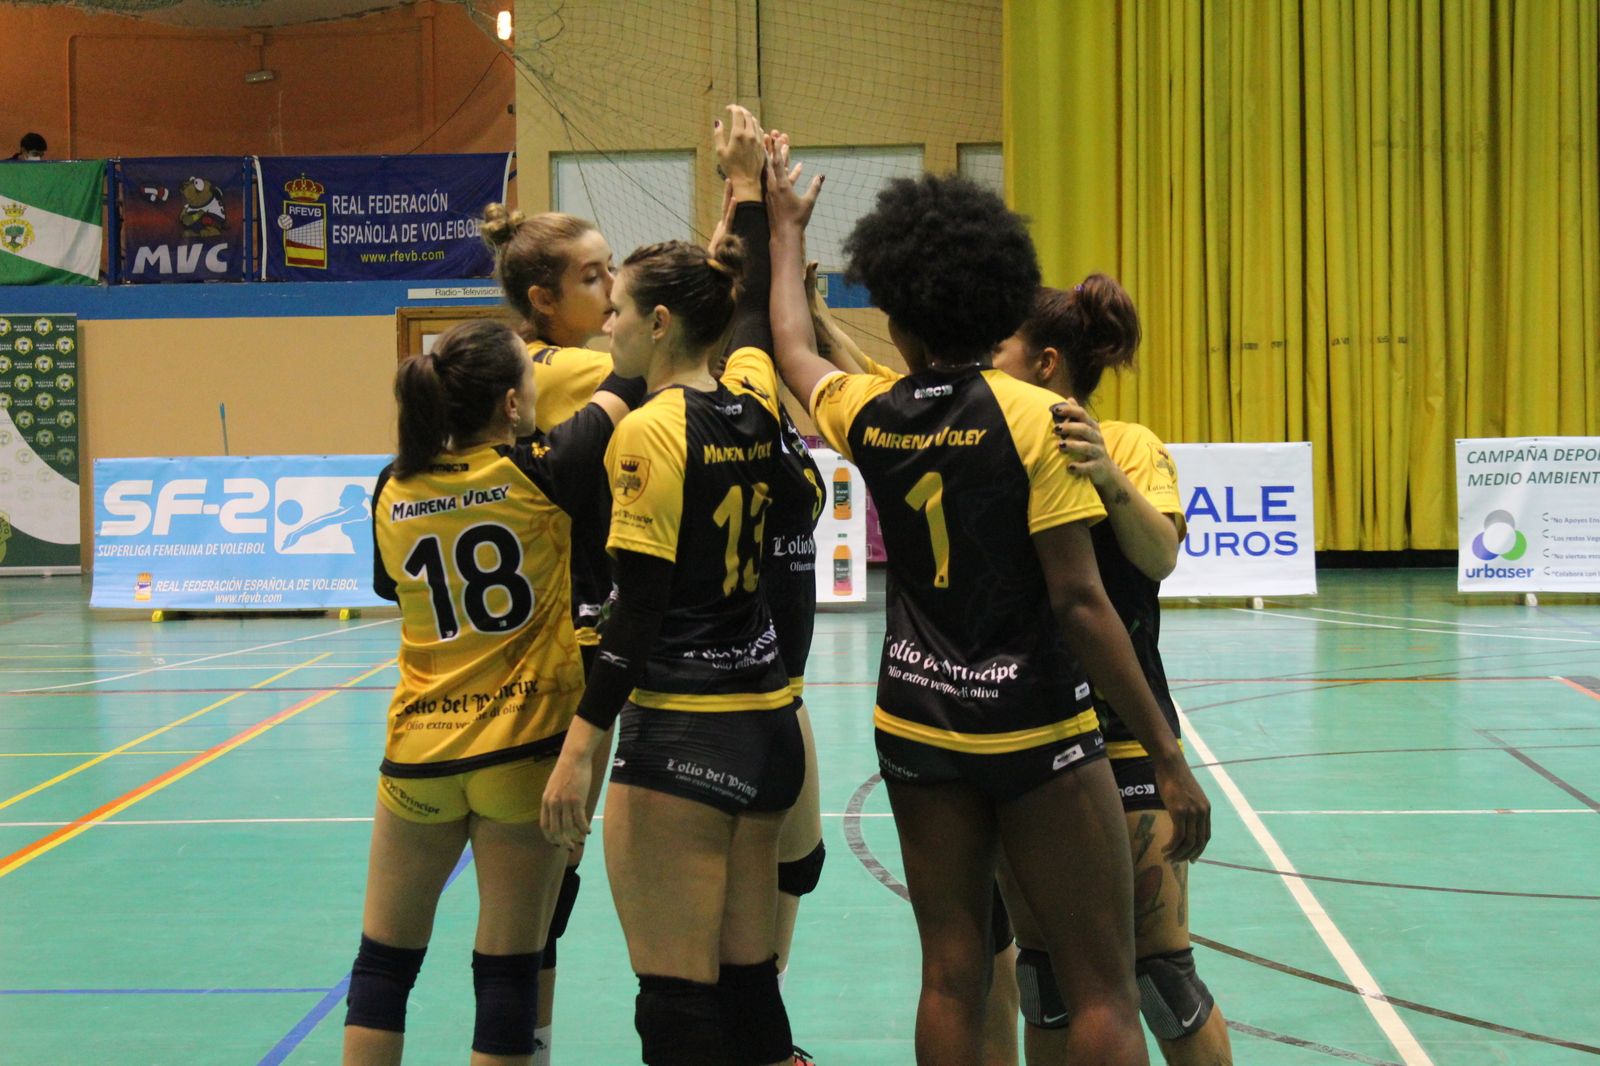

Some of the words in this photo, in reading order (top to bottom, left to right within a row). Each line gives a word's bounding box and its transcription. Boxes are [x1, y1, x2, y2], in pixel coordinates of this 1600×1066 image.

[289, 205, 322, 217] RFEVB
[332, 195, 365, 214] REAL
[368, 189, 448, 214] FEDERACIÓN
[332, 220, 399, 244] ESPAÑOLA
[401, 223, 418, 242] DE
[132, 243, 228, 274] MVC
[360, 250, 445, 262] www.rfevb.com
[435, 288, 499, 296] Radio-Televisión
[934, 426, 987, 447] VOLEY
[1467, 446, 1548, 464] CAMPAÑA
[1467, 472, 1522, 487] MEDIO
[99, 478, 270, 536] SF-2
[392, 497, 457, 522] MAIRENA
[463, 486, 511, 507] VOLEY
[905, 471, 949, 588] 1
[98, 544, 152, 557] SUPERLIGA
[153, 543, 203, 556] FEMENINA
[205, 543, 219, 555] DE
[220, 542, 266, 555] VOLEIBOL
[1185, 531, 1298, 557] UROS
[403, 522, 535, 640] 18
[1465, 564, 1534, 578] urbaser
[155, 581, 179, 592] REAL
[180, 577, 242, 592] FEDERACIÓN
[243, 577, 295, 591] ESPAÑOLA
[295, 579, 310, 591] DE
[311, 578, 359, 591] VOLEIBOL
[215, 593, 282, 604] www.rfevb.com
[886, 635, 920, 664] 'olio
[902, 671, 929, 687] extra
[970, 686, 999, 699] oliva
[442, 693, 469, 713] del
[426, 720, 453, 730] extra
[705, 768, 726, 784] del
